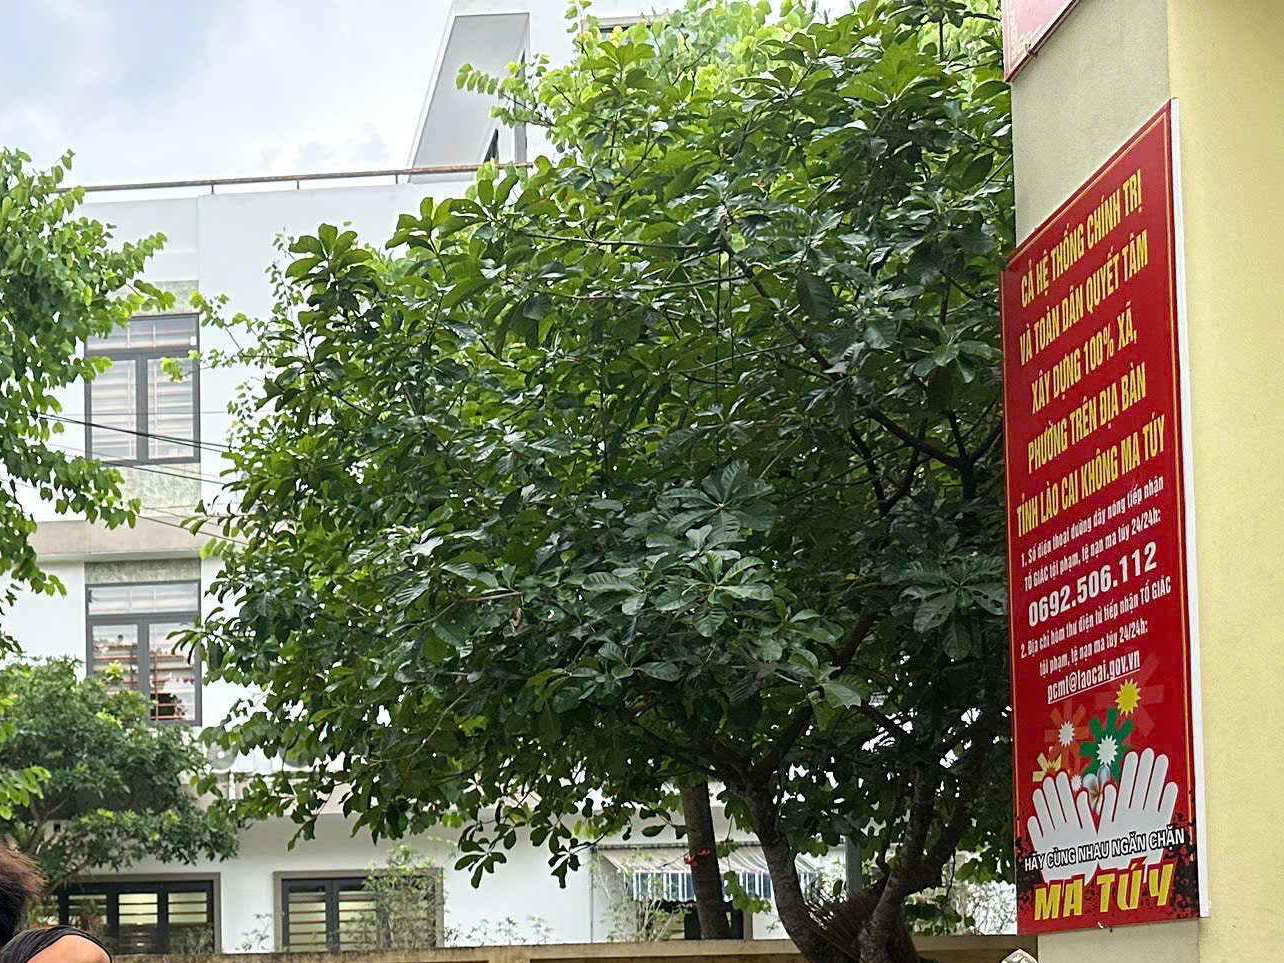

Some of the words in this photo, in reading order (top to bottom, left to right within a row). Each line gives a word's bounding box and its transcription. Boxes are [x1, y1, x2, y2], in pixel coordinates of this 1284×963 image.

[1021, 259, 1034, 308] CẢ
[1036, 249, 1049, 296] HỆ
[1051, 223, 1085, 281] THỐNG
[1086, 188, 1121, 250] CHÍNH
[1123, 169, 1142, 216] TRỊ
[1020, 323, 1033, 366] VÀ
[1034, 304, 1060, 354] TOÀN
[1062, 284, 1084, 333] DÂN
[1086, 246, 1120, 314] QUYẾT
[1122, 229, 1148, 282] TÂM
[1032, 369, 1051, 415] XÂY
[1053, 348, 1081, 400] DỰNG
[1083, 322, 1114, 375] 100%
[1117, 300, 1138, 351] XÃ,
[1028, 417, 1068, 475] PHƯỜNG
[1069, 395, 1098, 445] TRÊN
[1099, 382, 1119, 429] ĐỊA
[1121, 361, 1146, 412] BÀN
[1016, 492, 1039, 537] TỈNH
[1040, 481, 1059, 524] LÀO
[1061, 470, 1079, 511] CAI
[1081, 445, 1118, 499] KHÔNG
[1121, 432, 1141, 475] MA
[1142, 412, 1165, 461] TÚY
[1021, 552, 1028, 568] 1.
[1028, 544, 1037, 564] Số
[1037, 539, 1052, 559] điện
[1052, 527, 1070, 549] thoại
[1070, 517, 1092, 541] đường
[1093, 508, 1106, 528] dây
[1107, 497, 1126, 520] nóng
[1127, 482, 1142, 509] tiếp
[1143, 475, 1164, 499] nhận
[1090, 538, 1104, 558] nạn
[1105, 531, 1117, 549] ma
[1118, 523, 1130, 543] túy
[1131, 506, 1161, 536] 24/24h:
[1020, 643, 1027, 659] 2.
[1066, 620, 1077, 639] thư
[1078, 613, 1094, 634] điện
[1104, 598, 1118, 620] tiếp
[1120, 592, 1138, 614] nhận
[1140, 579, 1150, 605] TỐ
[1152, 575, 1171, 600] GIÁC
[1028, 541, 1157, 627] 0692.506.112
[1047, 649, 1141, 704] pcmt@laocai.gov.vn
[1079, 643, 1093, 661] nạn
[1094, 637, 1106, 655] ma
[1119, 618, 1148, 644] 24/24h:
[1024, 852, 1044, 872] HÃY
[1047, 847, 1076, 867] CÙNG
[1078, 842, 1109, 862] NHAU
[1112, 832, 1146, 856] NGĂN
[1148, 825, 1185, 850] CHẶN
[1034, 879, 1083, 921] MA
[1096, 863, 1174, 913] TÚY
